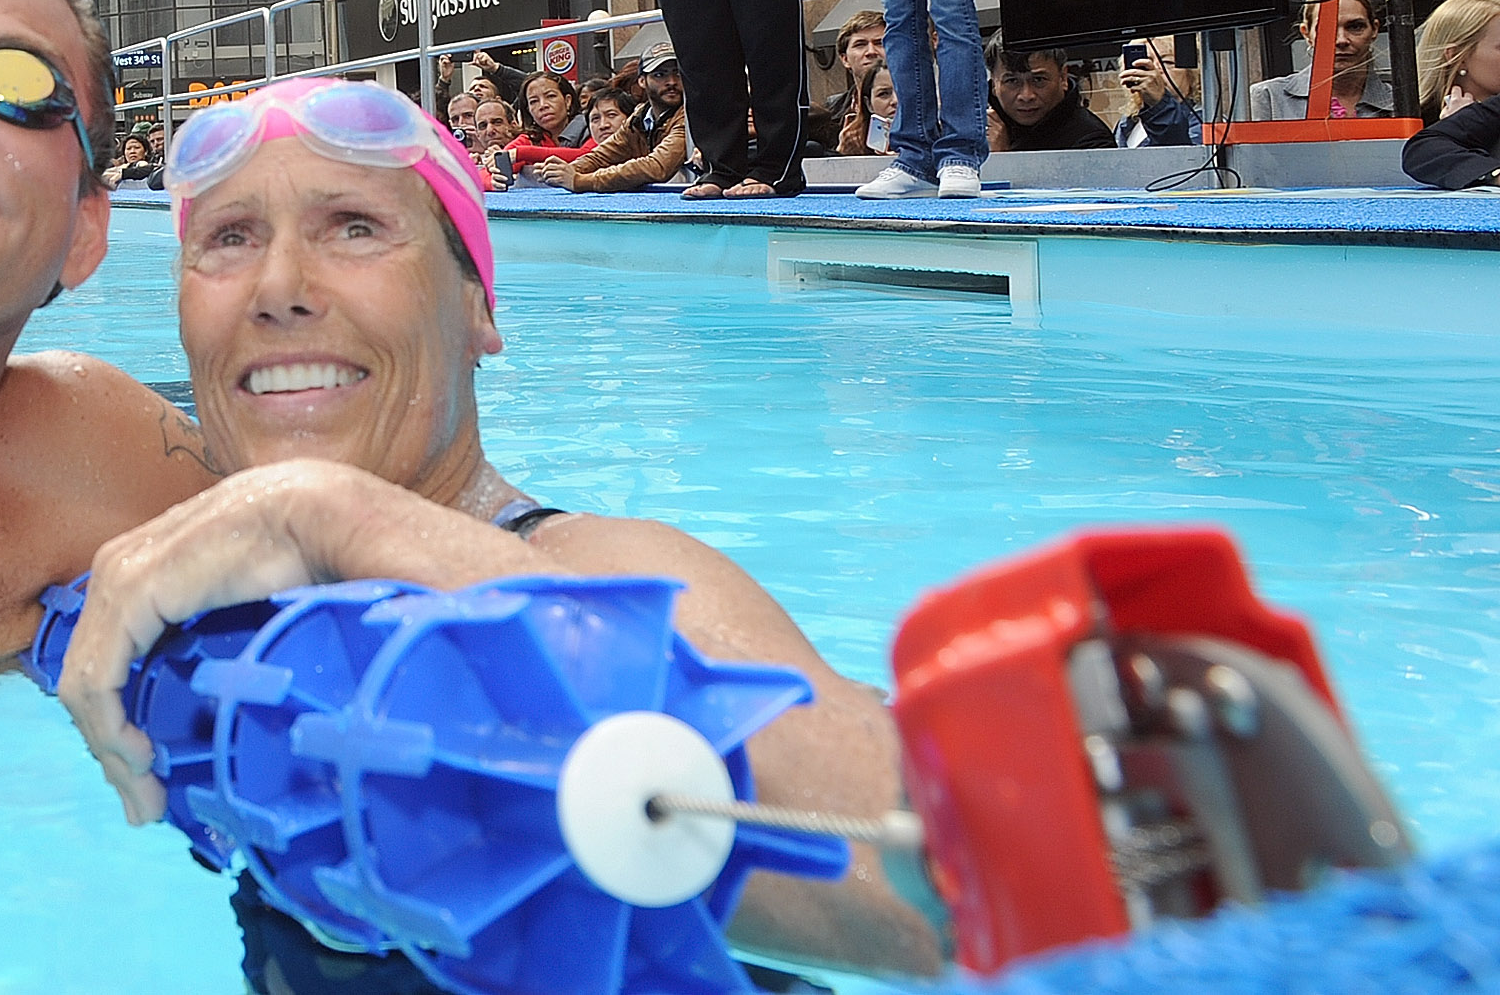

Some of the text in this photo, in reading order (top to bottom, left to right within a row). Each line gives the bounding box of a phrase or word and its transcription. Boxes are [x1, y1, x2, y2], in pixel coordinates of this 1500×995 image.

[549, 46, 570, 57] BURGER
[134, 55, 150, 65] 34th
[151, 55, 161, 64] St
[550, 52, 571, 64] KING
